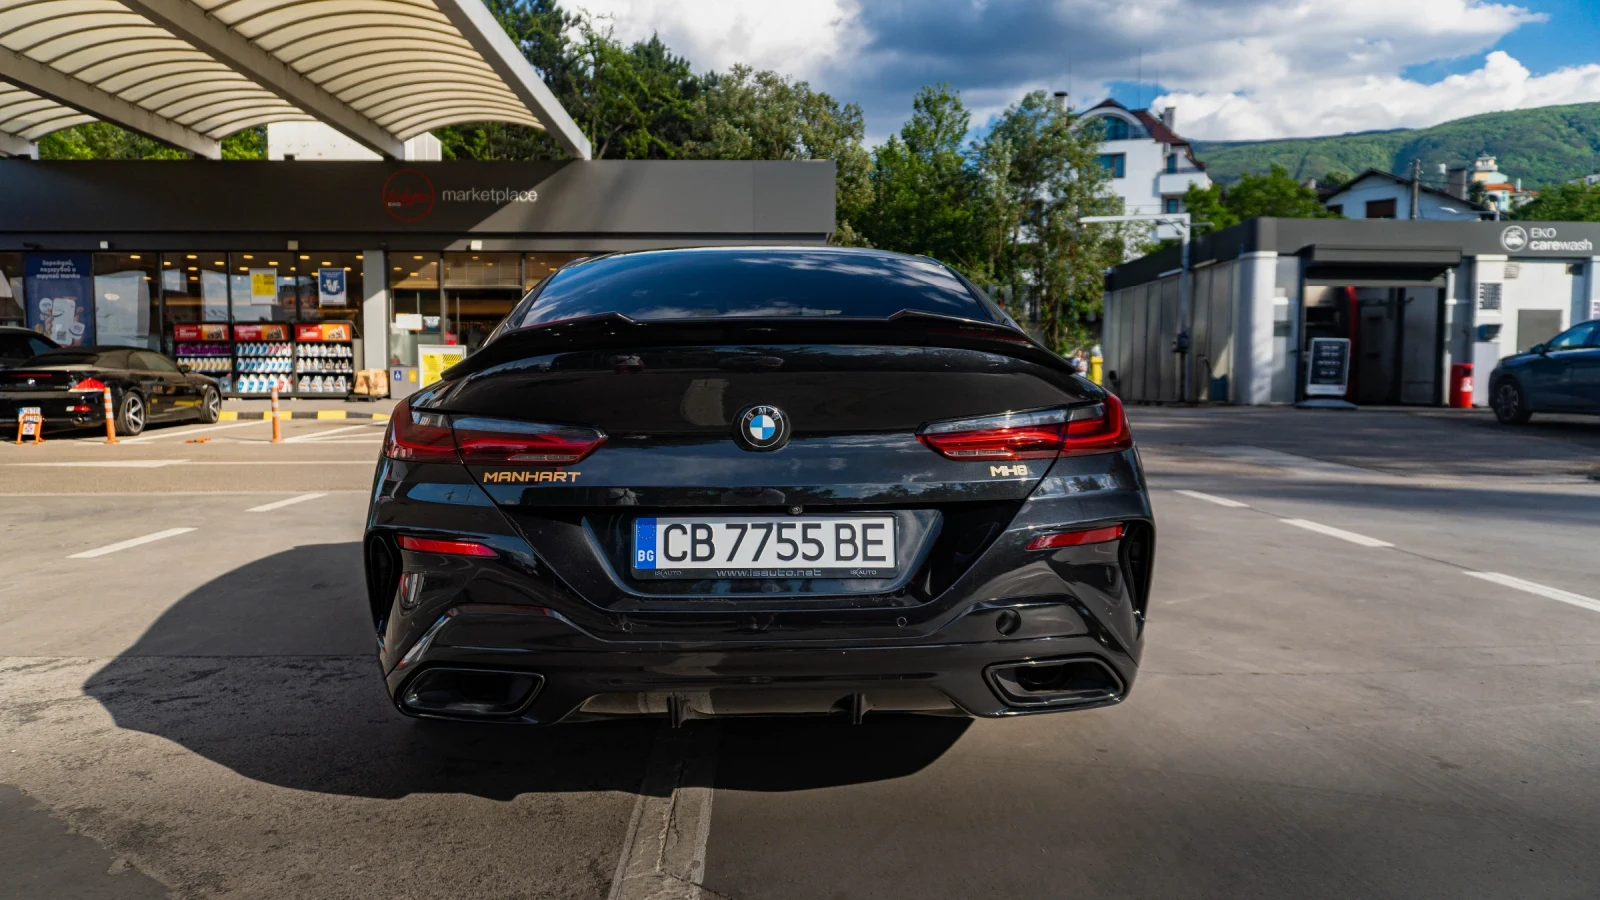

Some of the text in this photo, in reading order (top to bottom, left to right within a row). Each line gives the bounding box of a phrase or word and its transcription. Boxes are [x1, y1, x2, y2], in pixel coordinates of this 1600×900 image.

[442, 187, 538, 204] marketplace
[1531, 228, 1556, 238] EKO
[1530, 238, 1592, 250] carewash
[483, 471, 582, 483] MANHART
[663, 522, 887, 562] CB 7755 BE
[637, 550, 655, 562] BG
[716, 568, 822, 577] www.isauto.net
